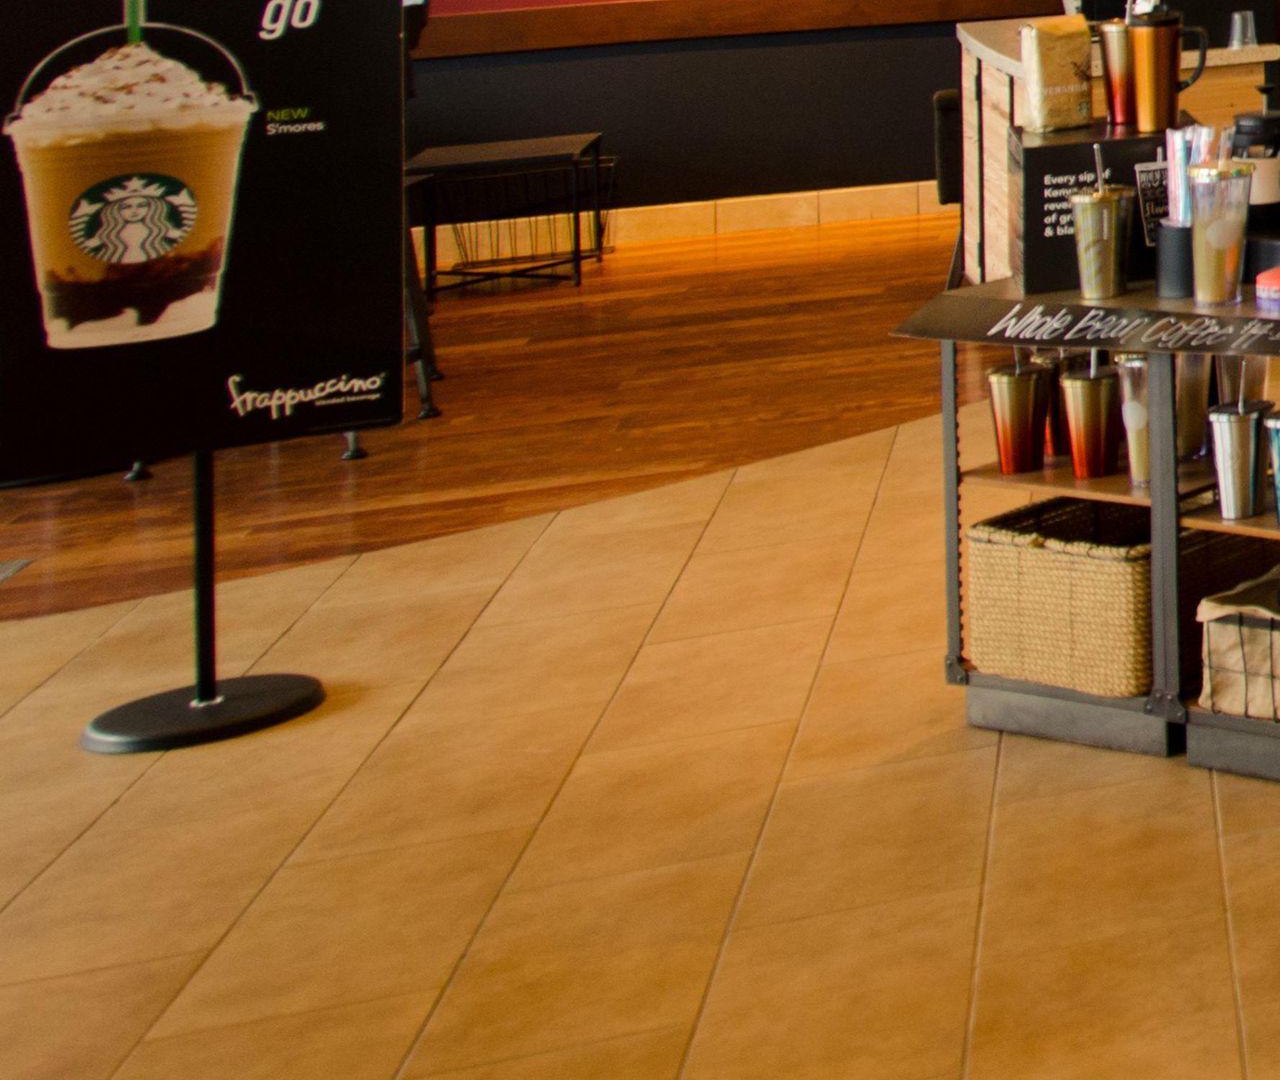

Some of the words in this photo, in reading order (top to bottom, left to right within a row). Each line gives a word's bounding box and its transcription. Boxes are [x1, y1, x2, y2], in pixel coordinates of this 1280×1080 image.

[266, 107, 309, 122] NEW
[265, 120, 325, 136] S'mores
[1043, 174, 1076, 186] Every
[1078, 170, 1095, 183] sip
[1043, 212, 1057, 225] of
[1043, 226, 1054, 238] &
[986, 300, 1070, 341] Whole
[1064, 307, 1144, 345] Bean
[1140, 315, 1235, 349] Coffee
